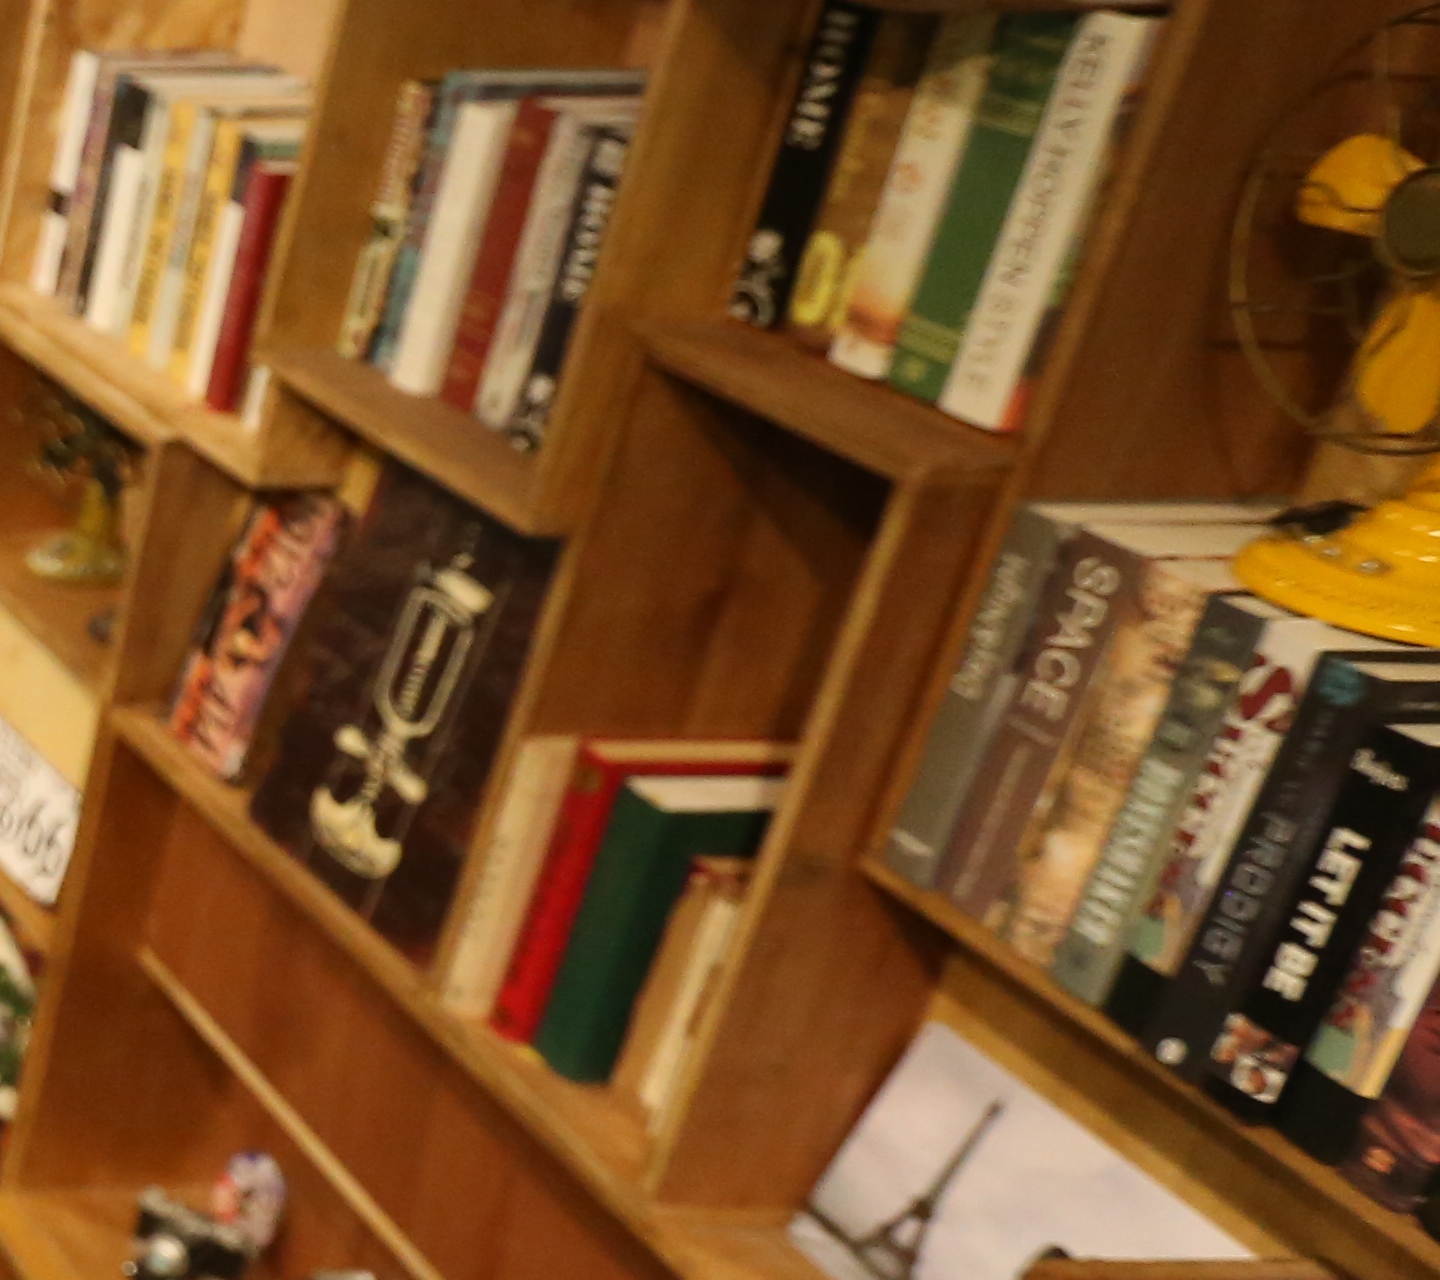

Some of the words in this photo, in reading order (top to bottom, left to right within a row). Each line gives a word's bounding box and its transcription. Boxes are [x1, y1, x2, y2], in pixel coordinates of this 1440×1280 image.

[1021, 556, 1121, 720] SPACE
[1192, 812, 1298, 987] PRODIGY
[1308, 825, 1372, 905] LET
[1290, 900, 1339, 949] IT
[1262, 941, 1319, 1003] BE
